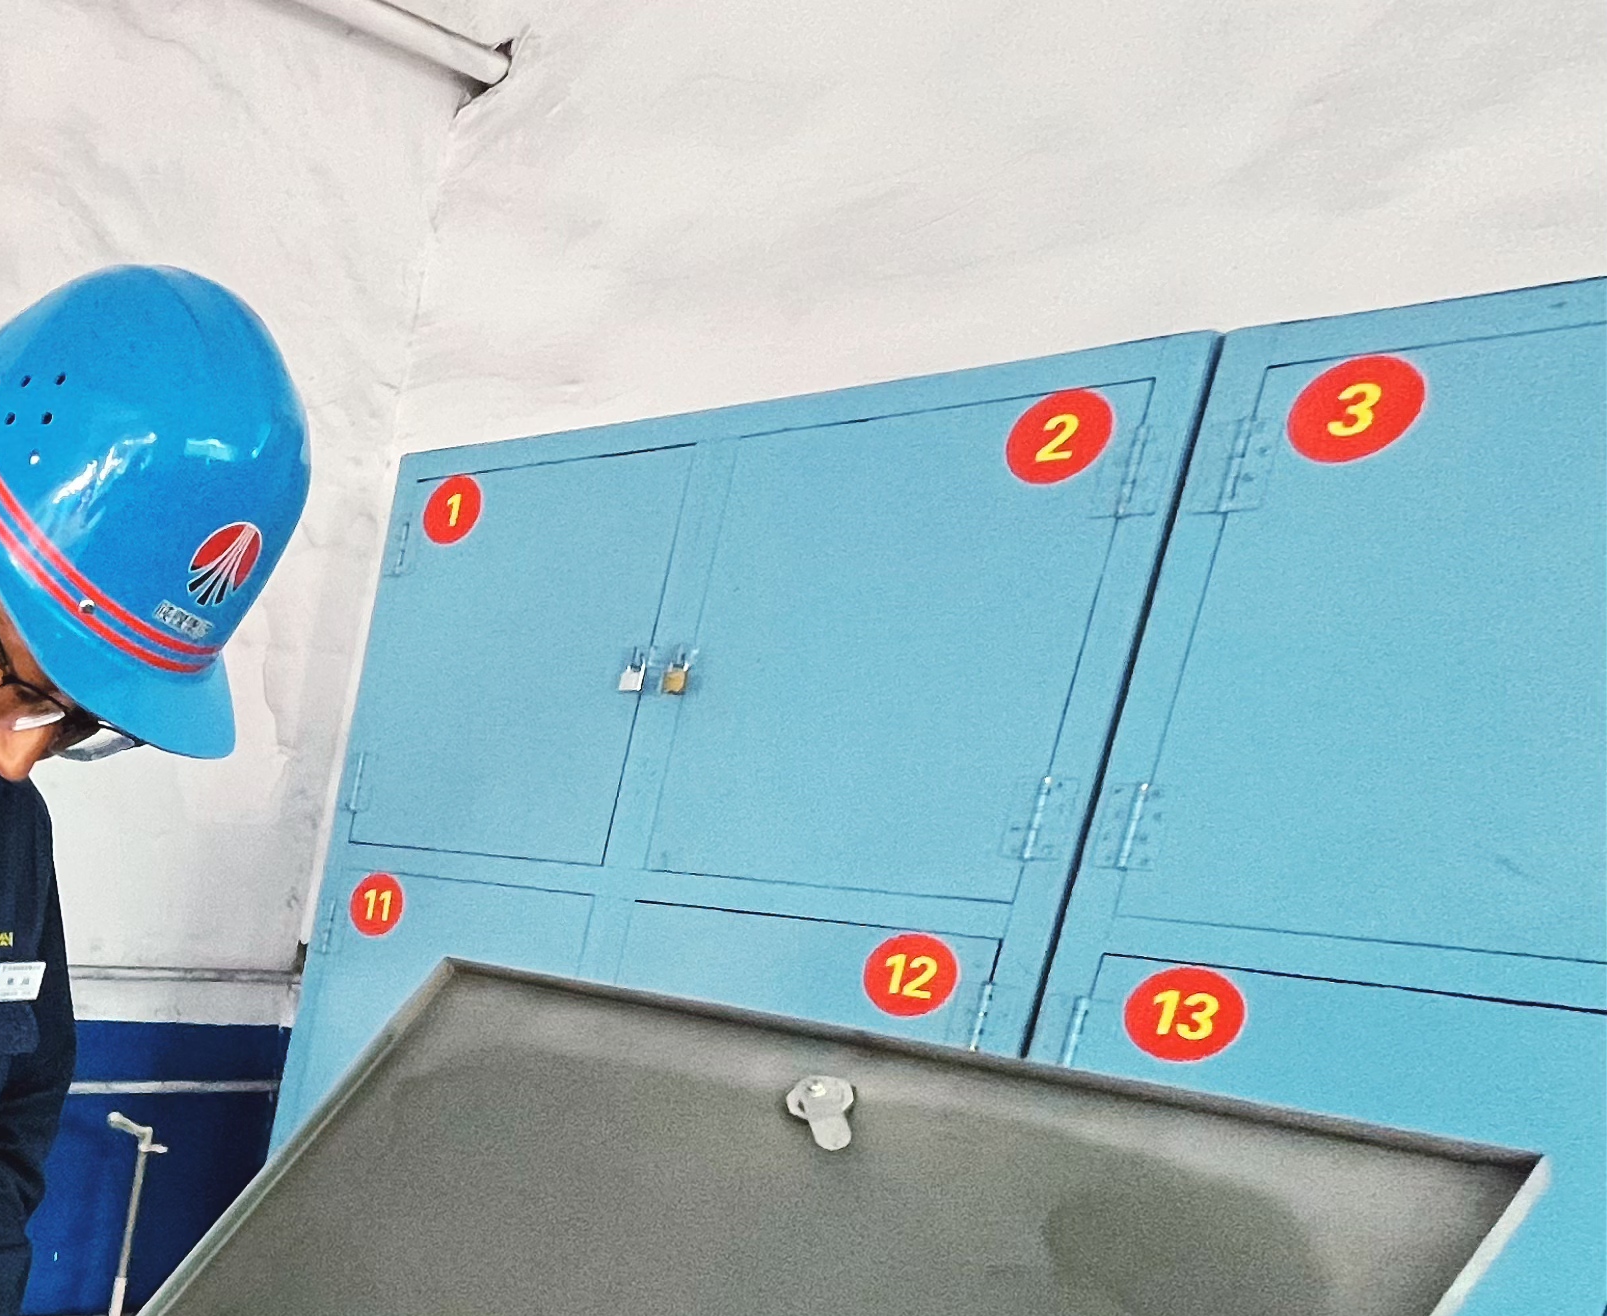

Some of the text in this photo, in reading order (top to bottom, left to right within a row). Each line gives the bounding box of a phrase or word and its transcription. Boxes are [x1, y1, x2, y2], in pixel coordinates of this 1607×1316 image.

[1328, 383, 1382, 437] 3
[1035, 413, 1079, 462] 2
[447, 493, 462, 527] 1
[364, 888, 392, 922] 11
[885, 953, 938, 999] 12
[1153, 989, 1219, 1040] 13
